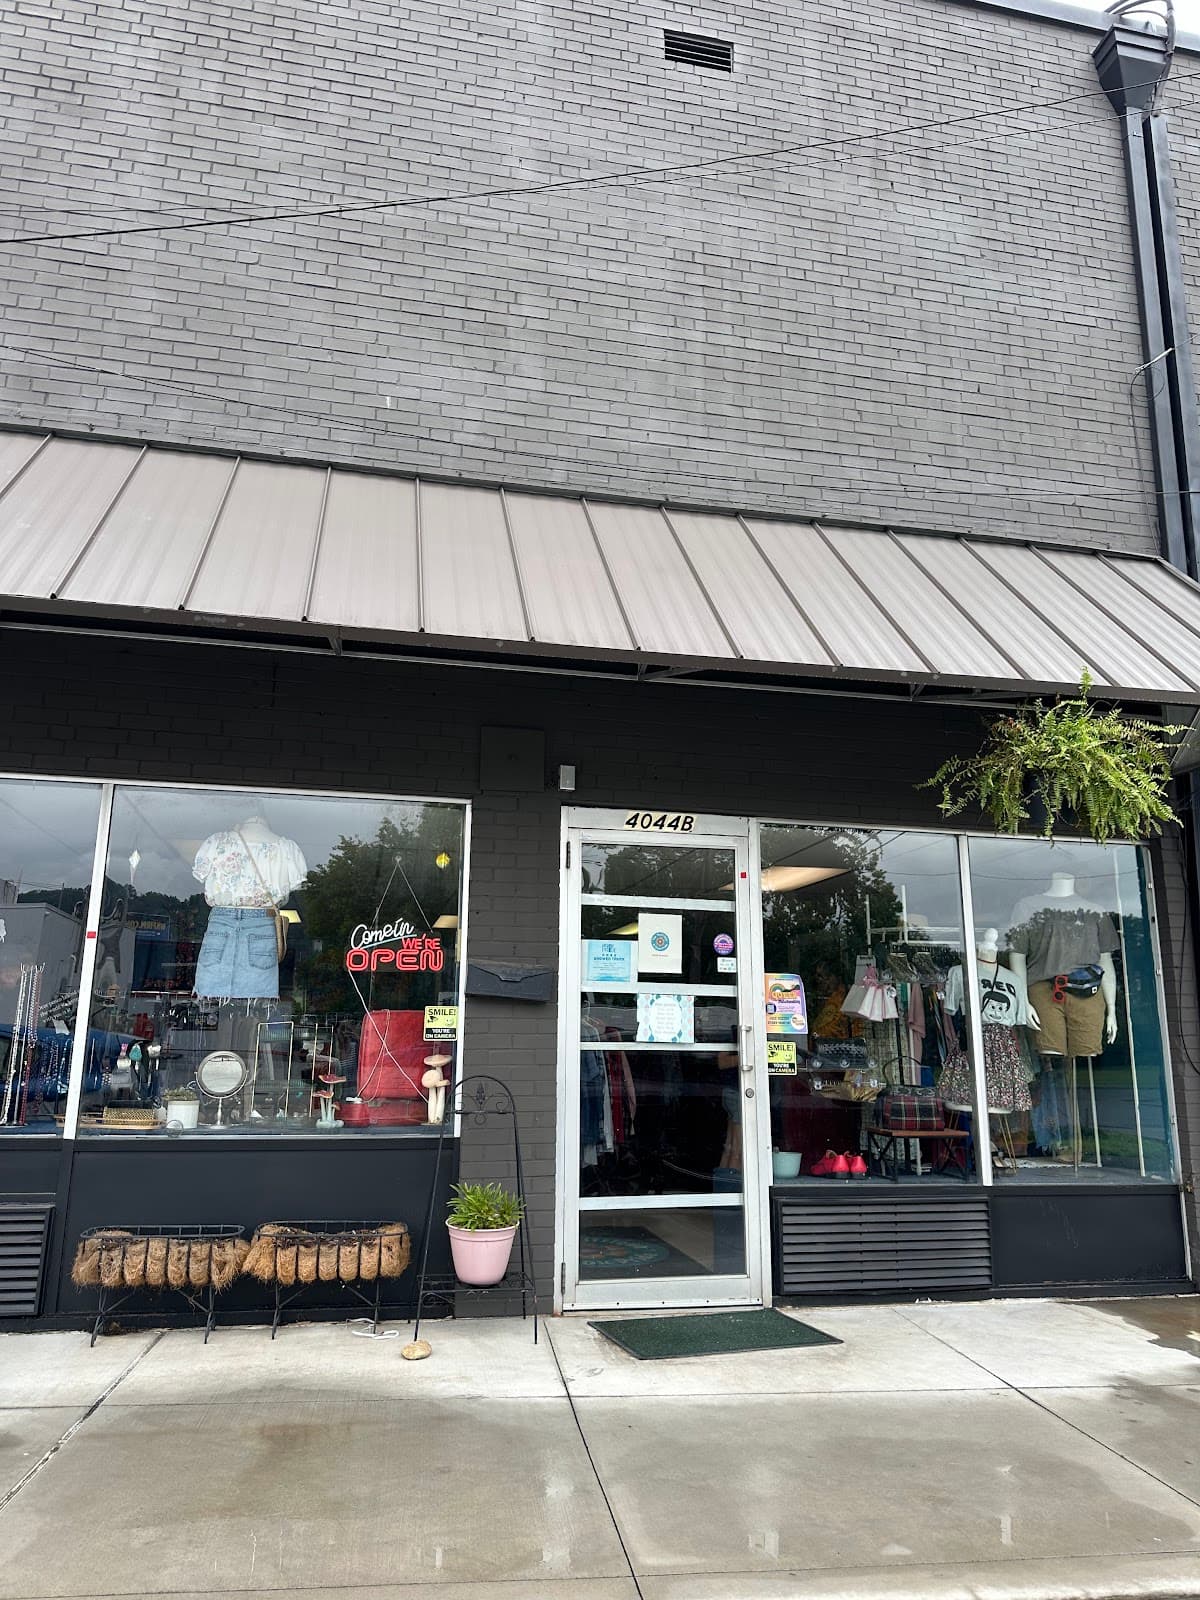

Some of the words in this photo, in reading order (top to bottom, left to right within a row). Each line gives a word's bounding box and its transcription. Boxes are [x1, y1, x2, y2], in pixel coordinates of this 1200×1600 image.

[625, 812, 695, 832] 4044B
[401, 933, 441, 950] WE'RE
[346, 948, 444, 971] OPEN
[428, 1008, 457, 1016] SMILE!
